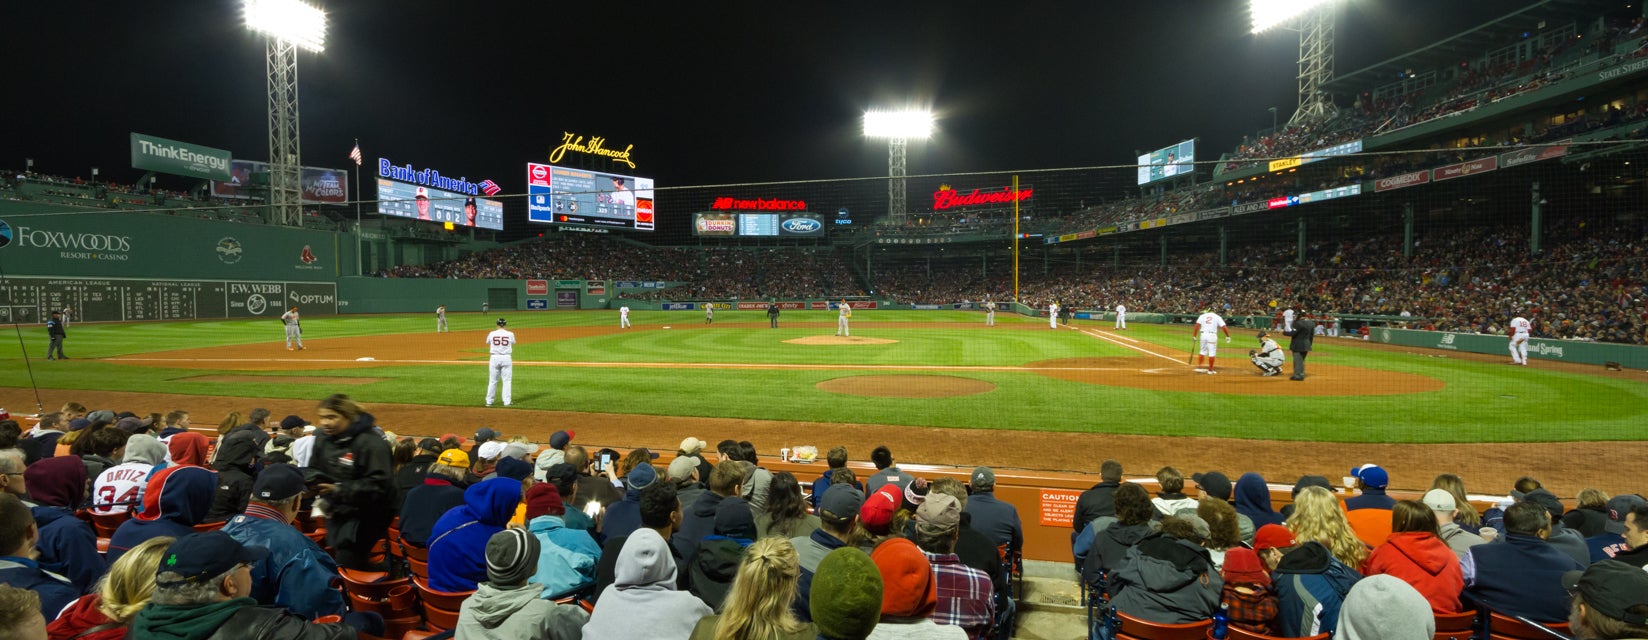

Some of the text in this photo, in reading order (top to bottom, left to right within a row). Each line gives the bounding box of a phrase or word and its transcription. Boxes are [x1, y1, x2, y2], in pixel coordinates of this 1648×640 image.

[1599, 59, 1648, 80] STATE STREE
[550, 131, 636, 168] John Hancock
[379, 158, 478, 195] Bank of America
[734, 199, 757, 208] new
[759, 198, 806, 210] balance
[934, 186, 1033, 210] Budweiser
[789, 220, 813, 231] Ford
[17, 226, 130, 252] FOXWOODS
[61, 252, 128, 261] RESORT CASINO
[251, 284, 281, 293] WEBB
[300, 295, 333, 304] OPTUM
[1206, 316, 1212, 324] 2
[493, 336, 509, 346] 55
[1528, 343, 1563, 357] and Spring
[106, 469, 146, 482] ORTIZ
[98, 486, 140, 512] 34
